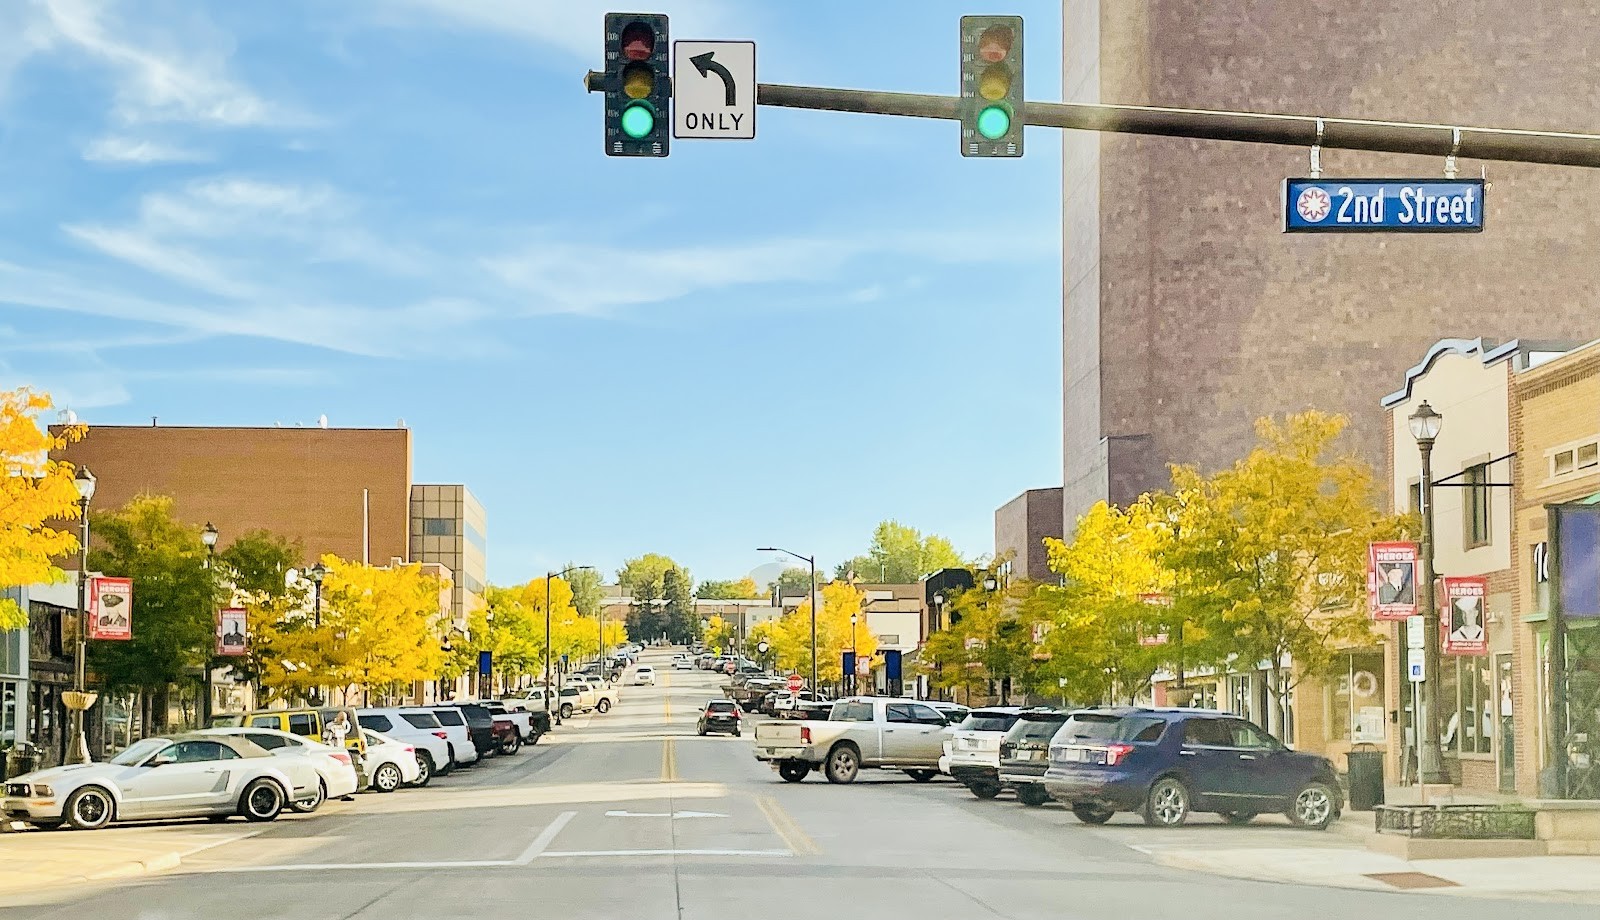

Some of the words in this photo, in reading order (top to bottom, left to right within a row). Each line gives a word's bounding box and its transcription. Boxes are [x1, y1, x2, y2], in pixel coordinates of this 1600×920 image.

[686, 112, 744, 131] ONLY
[1336, 186, 1385, 224] 2nd
[1398, 186, 1475, 224] Street
[1376, 552, 1415, 561] HEROES
[1449, 587, 1484, 596] HEROES
[787, 679, 803, 688] STOP
